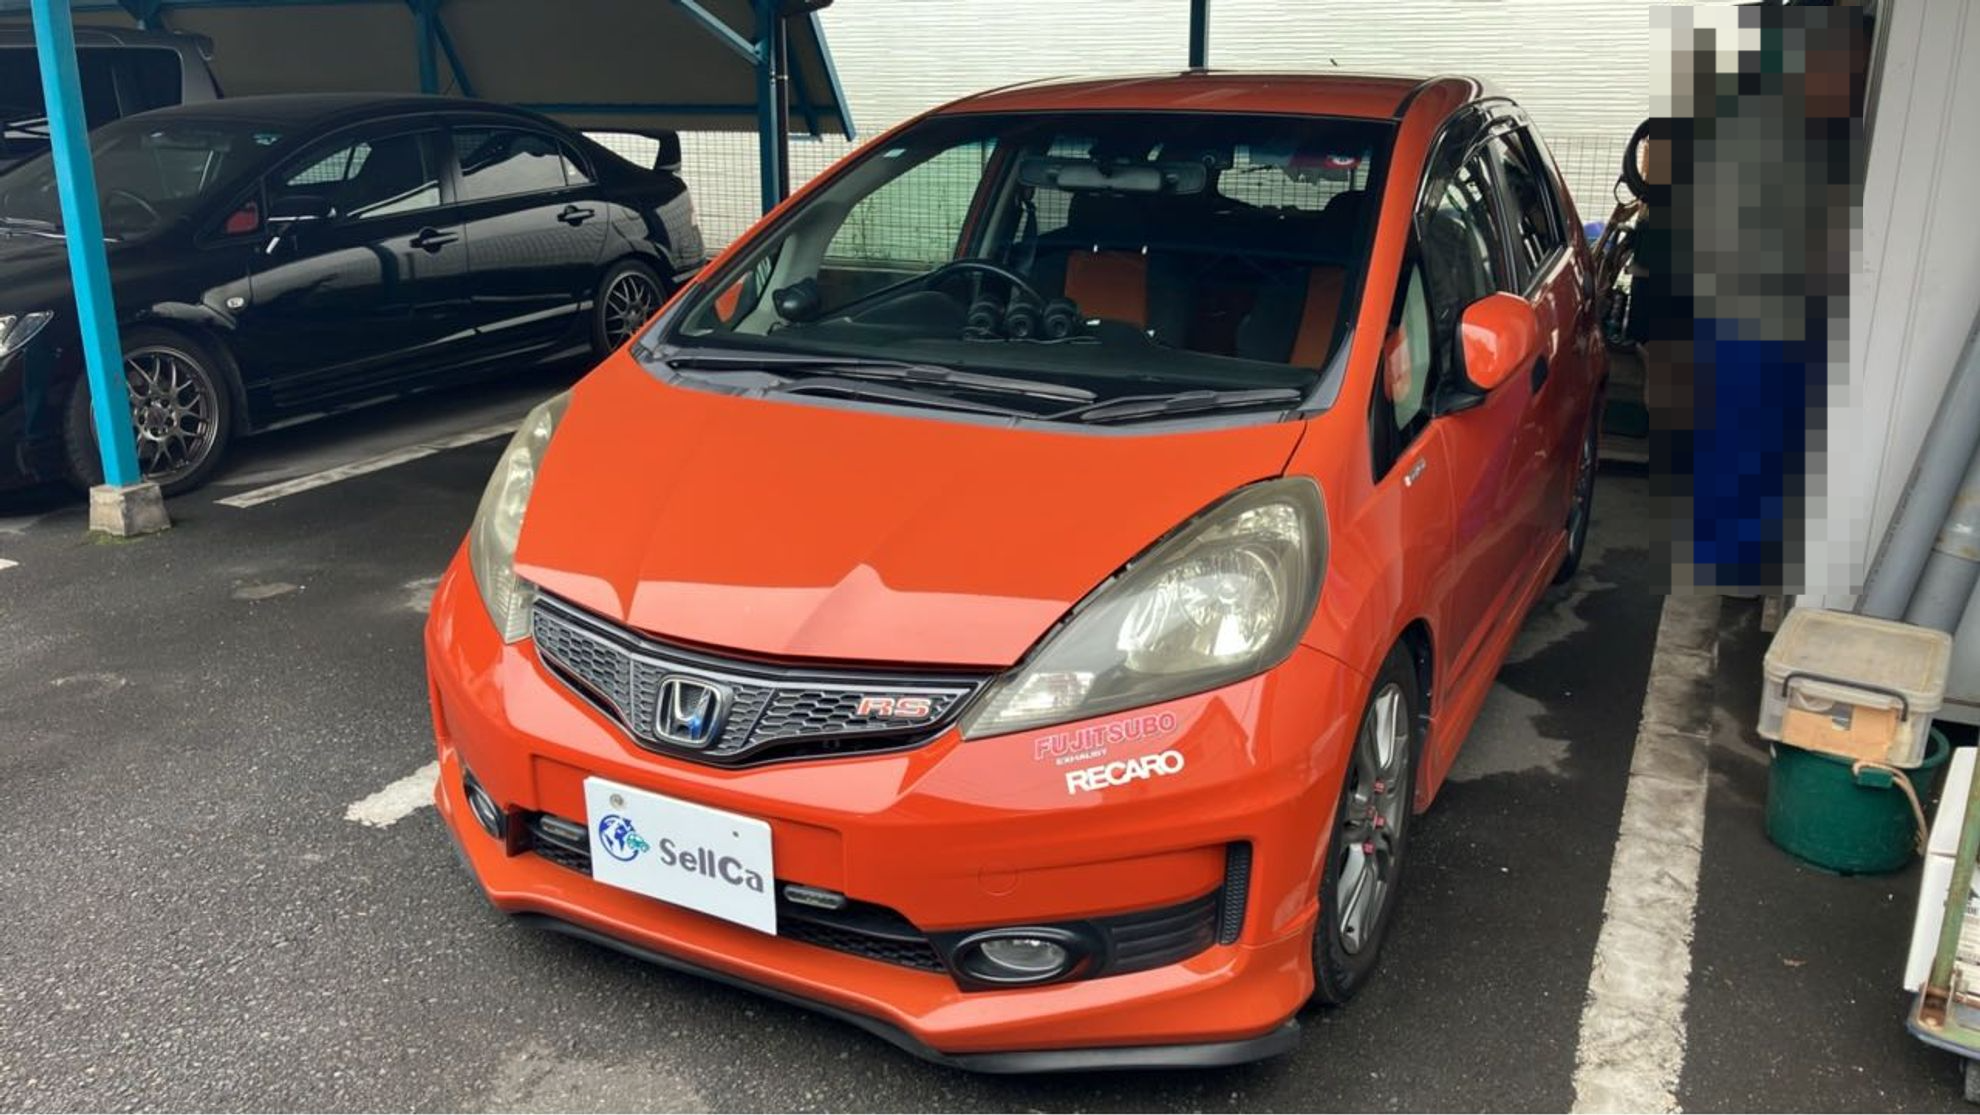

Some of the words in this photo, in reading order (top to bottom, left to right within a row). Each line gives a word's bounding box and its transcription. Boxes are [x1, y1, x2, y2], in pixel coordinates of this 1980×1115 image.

[857, 697, 932, 718] RS
[1034, 711, 1177, 760] FUJITSUBO
[1065, 750, 1185, 795] RECARO
[659, 837, 764, 893] SellCa
